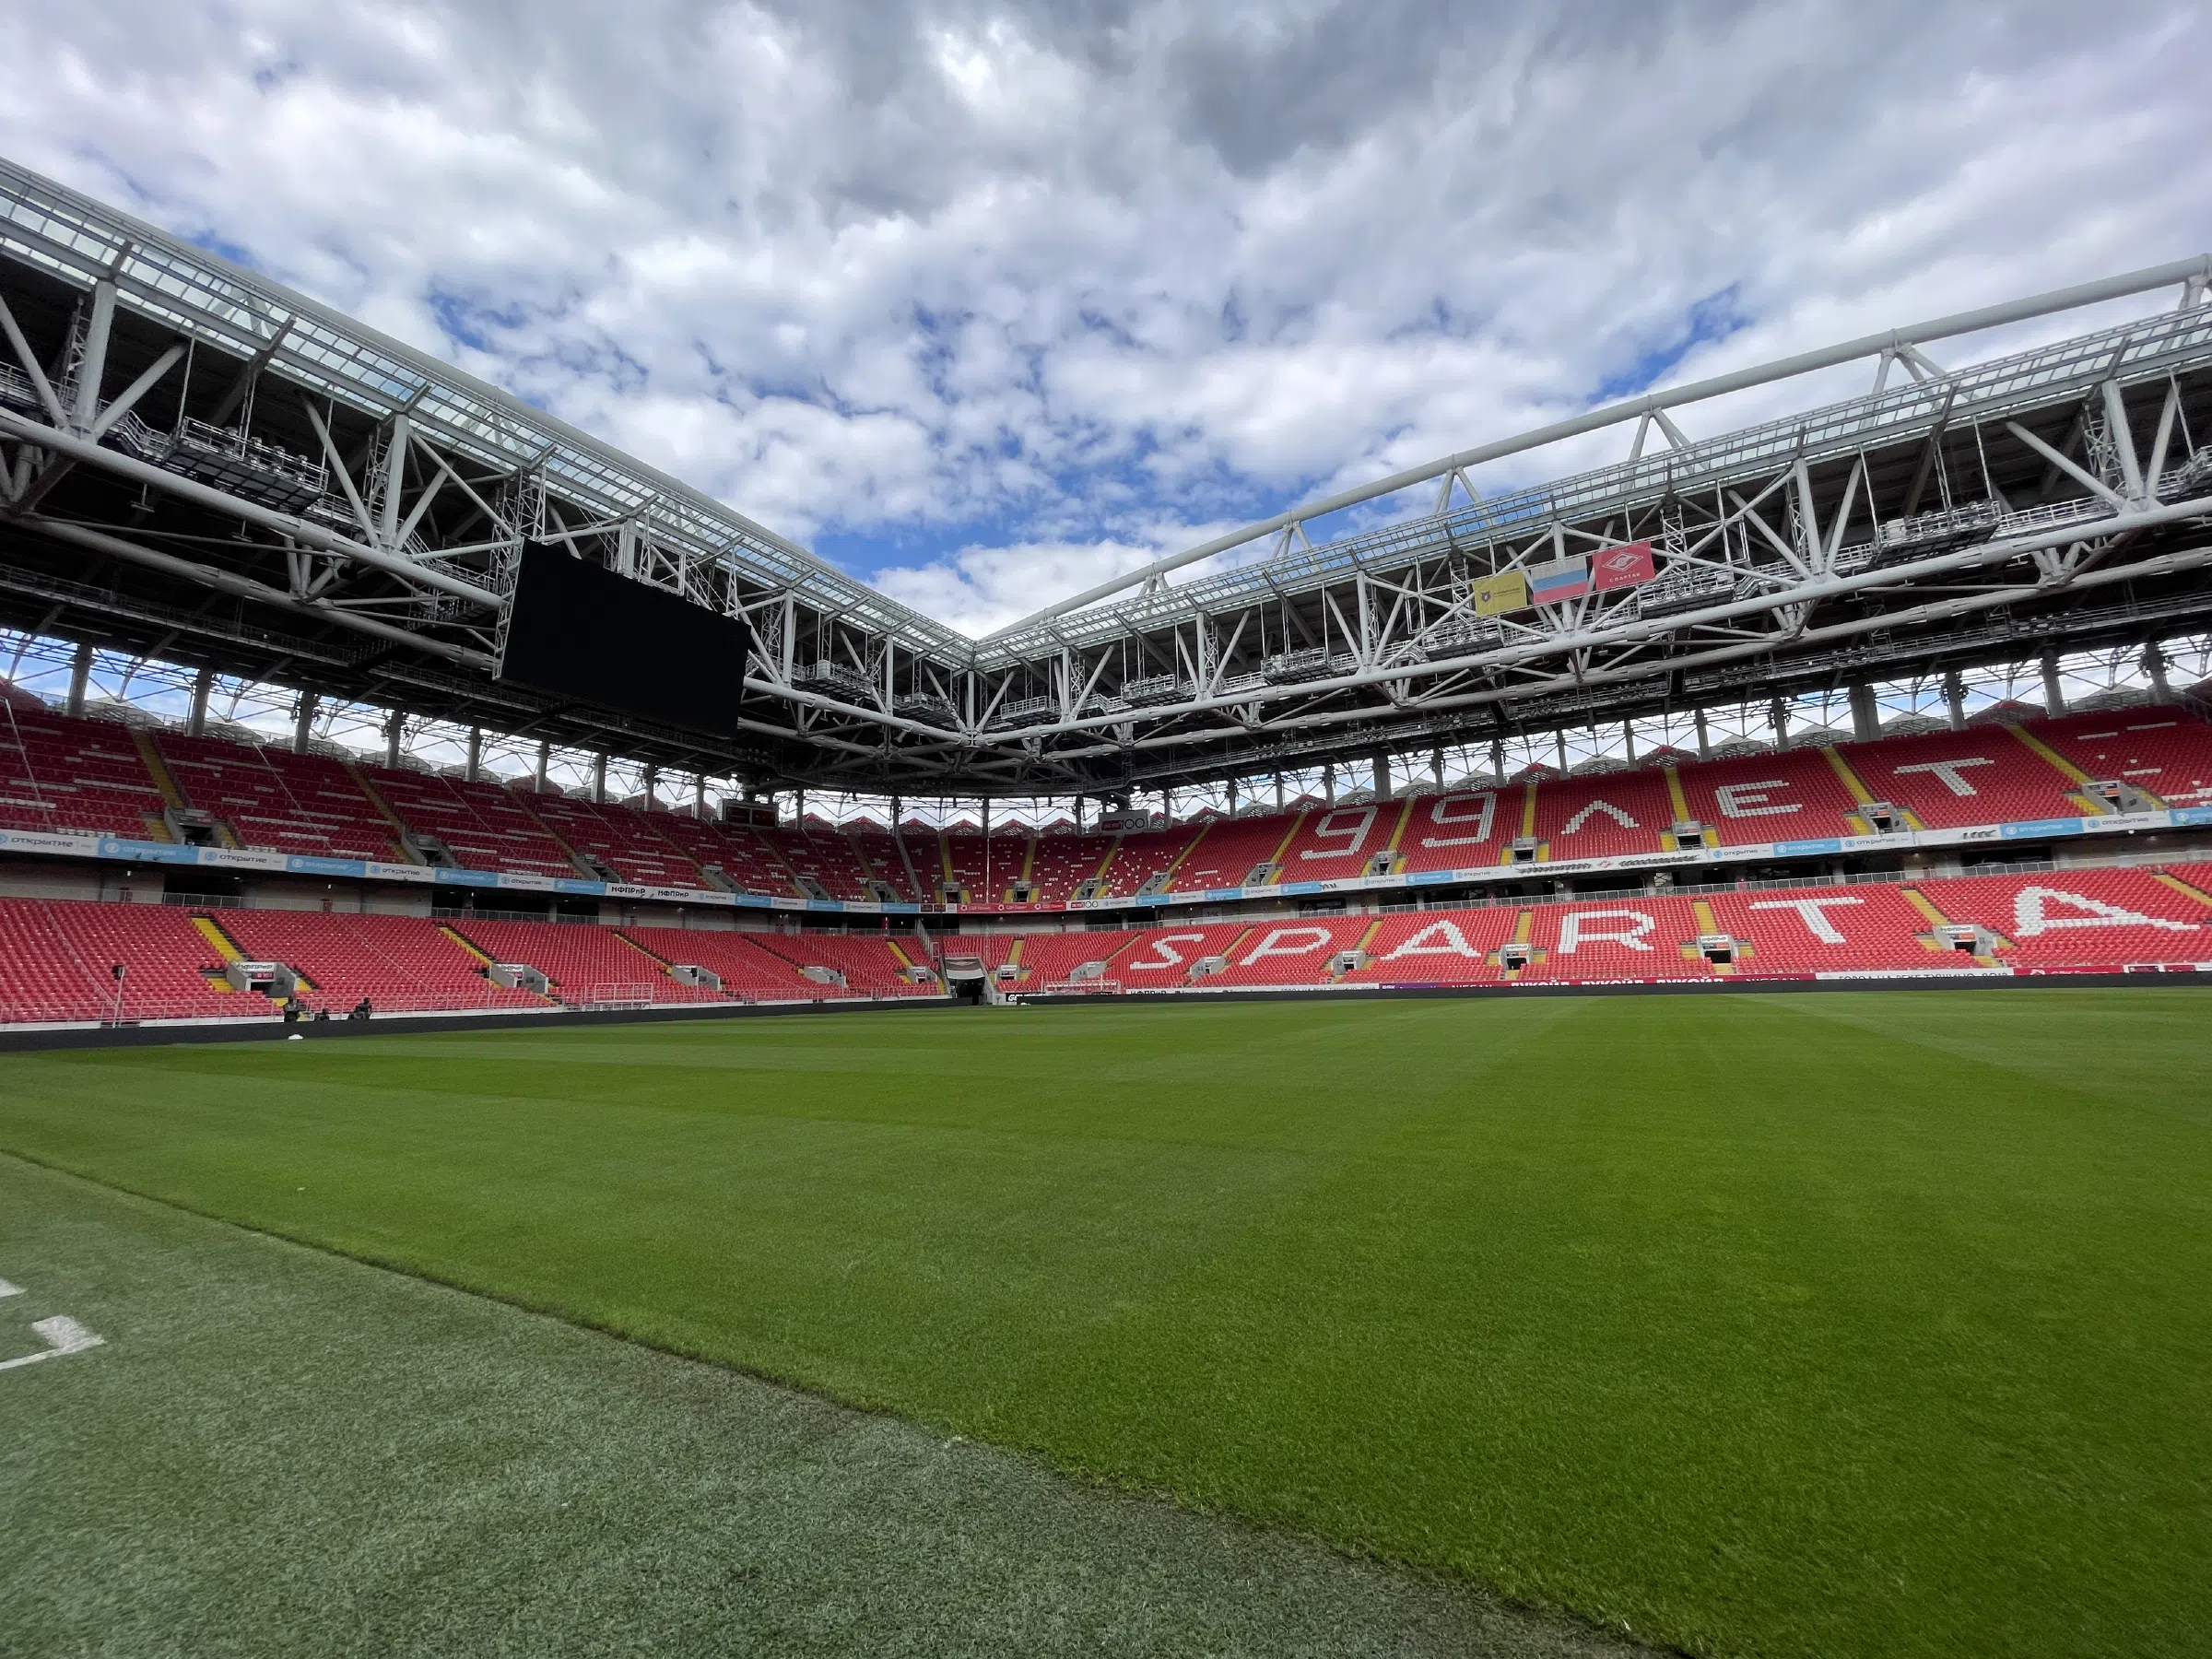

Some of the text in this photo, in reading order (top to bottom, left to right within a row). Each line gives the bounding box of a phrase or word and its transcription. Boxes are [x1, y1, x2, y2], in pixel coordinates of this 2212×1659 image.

[1609, 571, 1641, 582] СПАРТАК
[1122, 818, 1146, 830] 100
[2101, 816, 2149, 826] открытие
[11, 837, 74, 848] открытие
[1856, 837, 1896, 846] открытие
[219, 853, 267, 864] открытие
[382, 867, 420, 877] открытие
